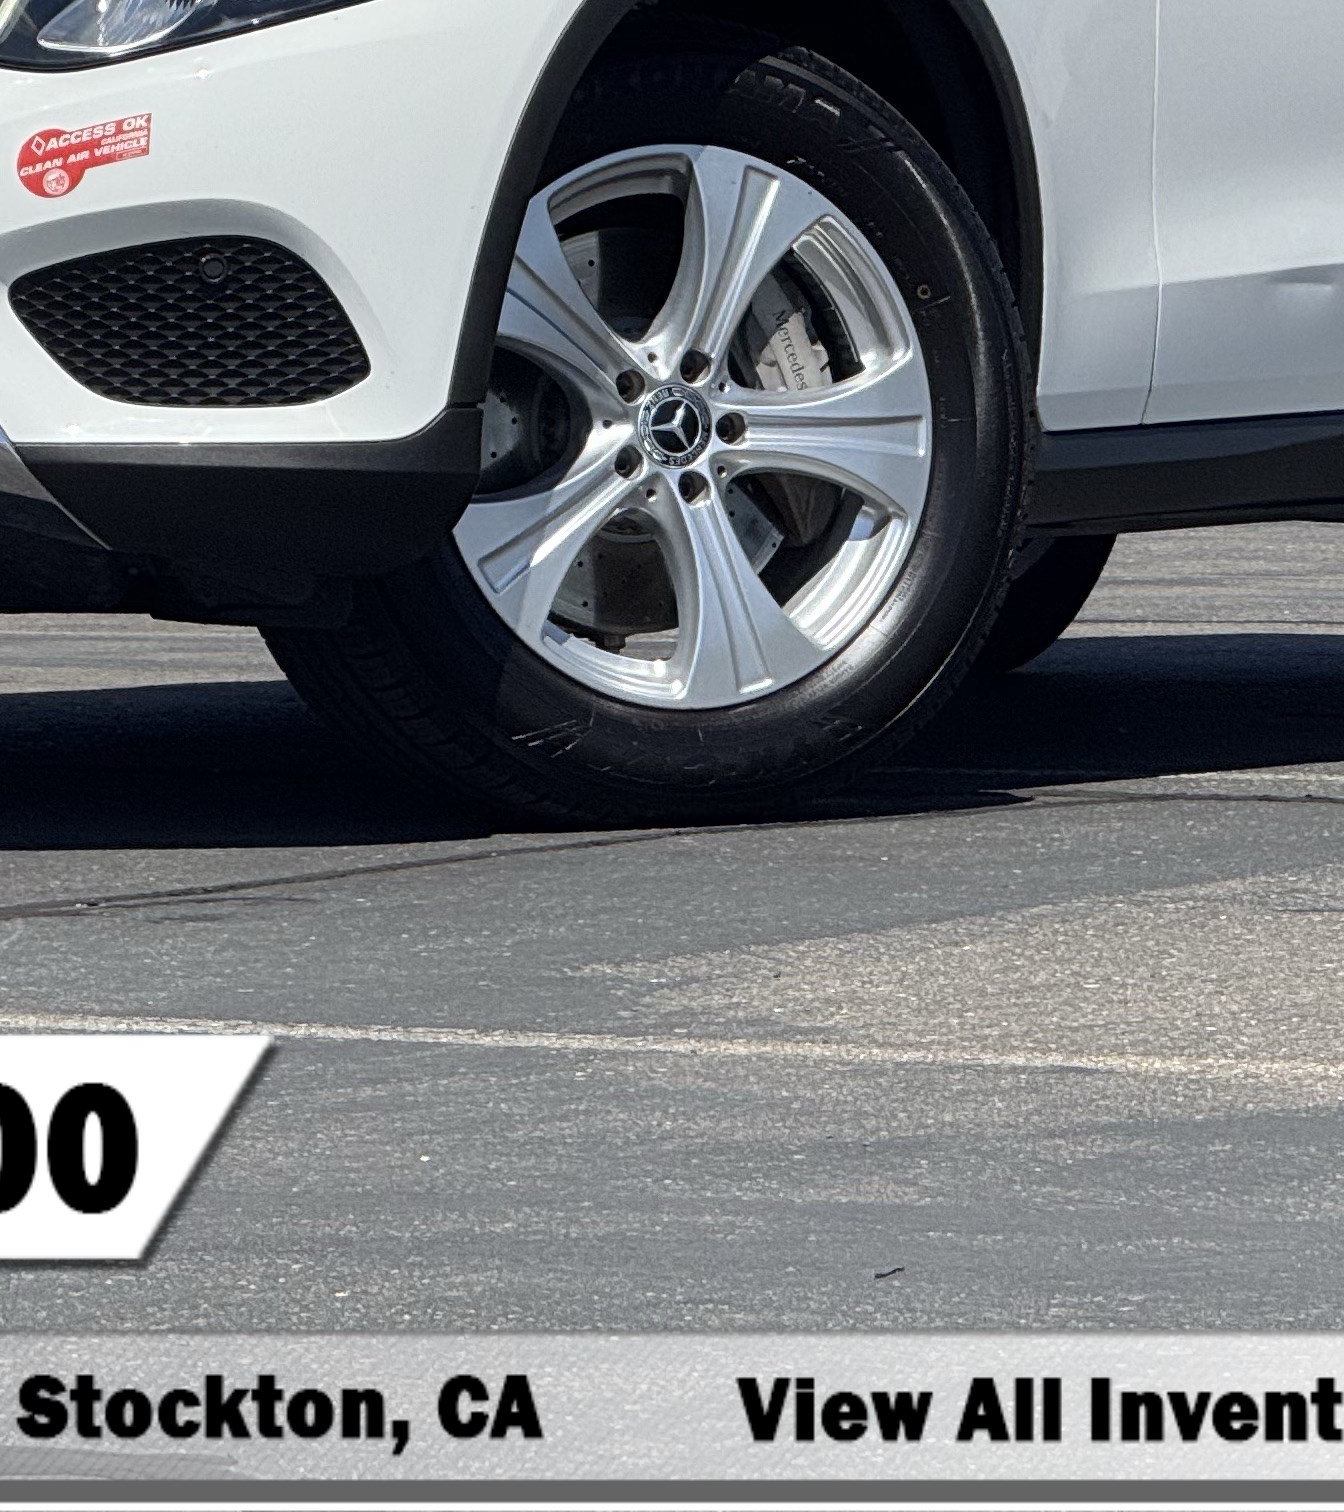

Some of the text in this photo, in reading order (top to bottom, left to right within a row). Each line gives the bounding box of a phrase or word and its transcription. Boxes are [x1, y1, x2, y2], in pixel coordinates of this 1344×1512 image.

[44, 114, 150, 152] ACCESS OK
[19, 156, 64, 178] CLEAN
[66, 150, 91, 165] AIR
[93, 136, 149, 157] VEHICLE
[772, 310, 808, 391] Mercedes
